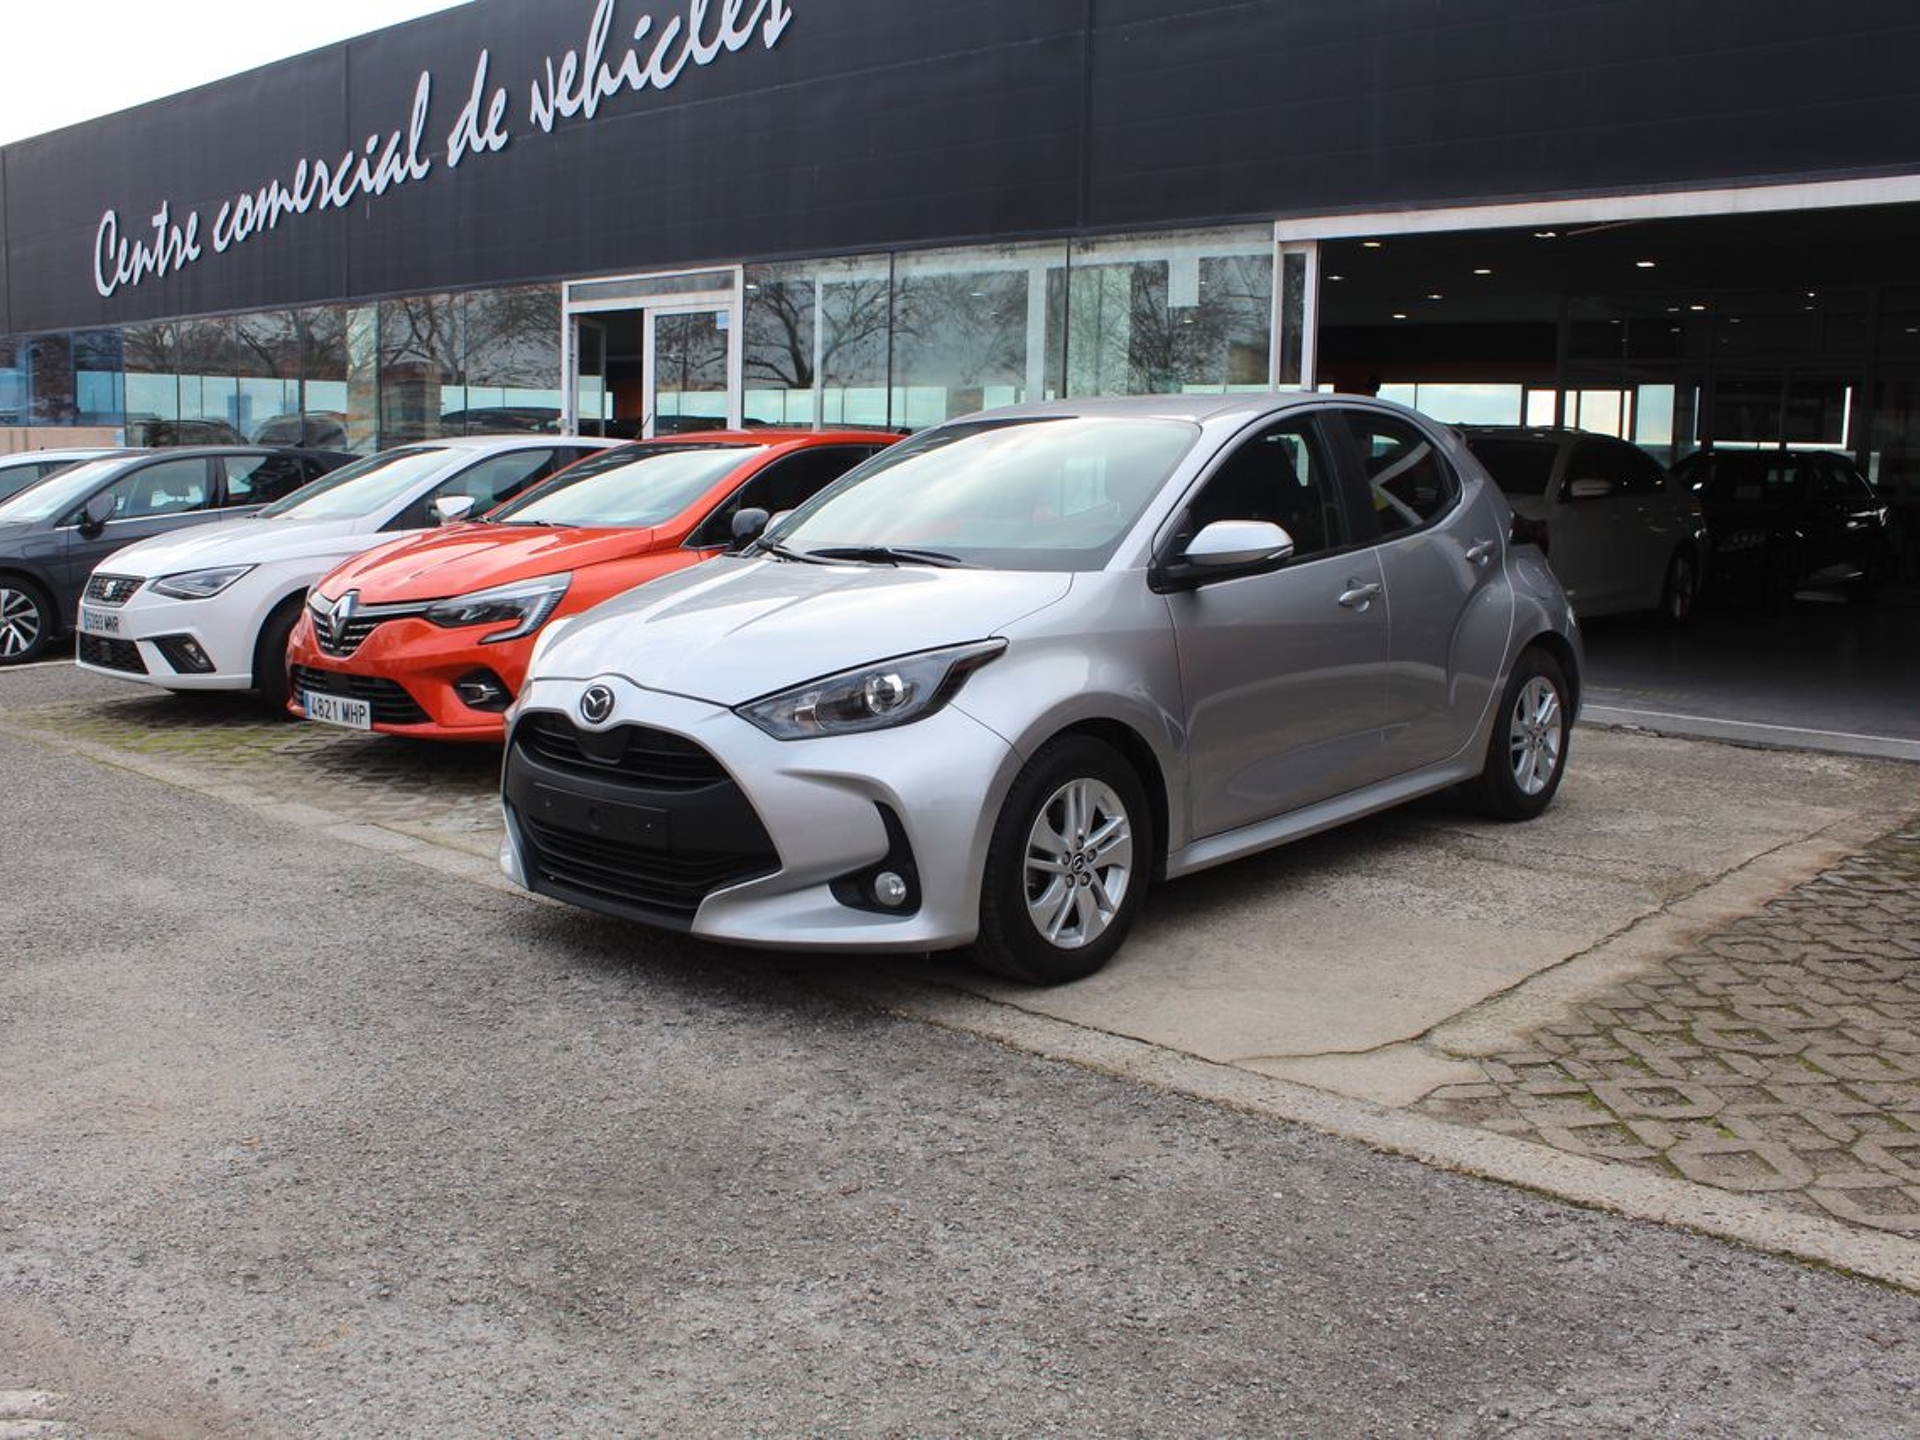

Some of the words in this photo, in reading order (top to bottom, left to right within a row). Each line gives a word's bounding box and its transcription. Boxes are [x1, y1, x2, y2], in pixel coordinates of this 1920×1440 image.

[94, 200, 200, 297] Centre
[212, 70, 431, 252] comercial
[447, 48, 508, 168] de
[529, 0, 792, 133] vehicles
[311, 696, 338, 720] 4821
[341, 702, 367, 725] MHP
